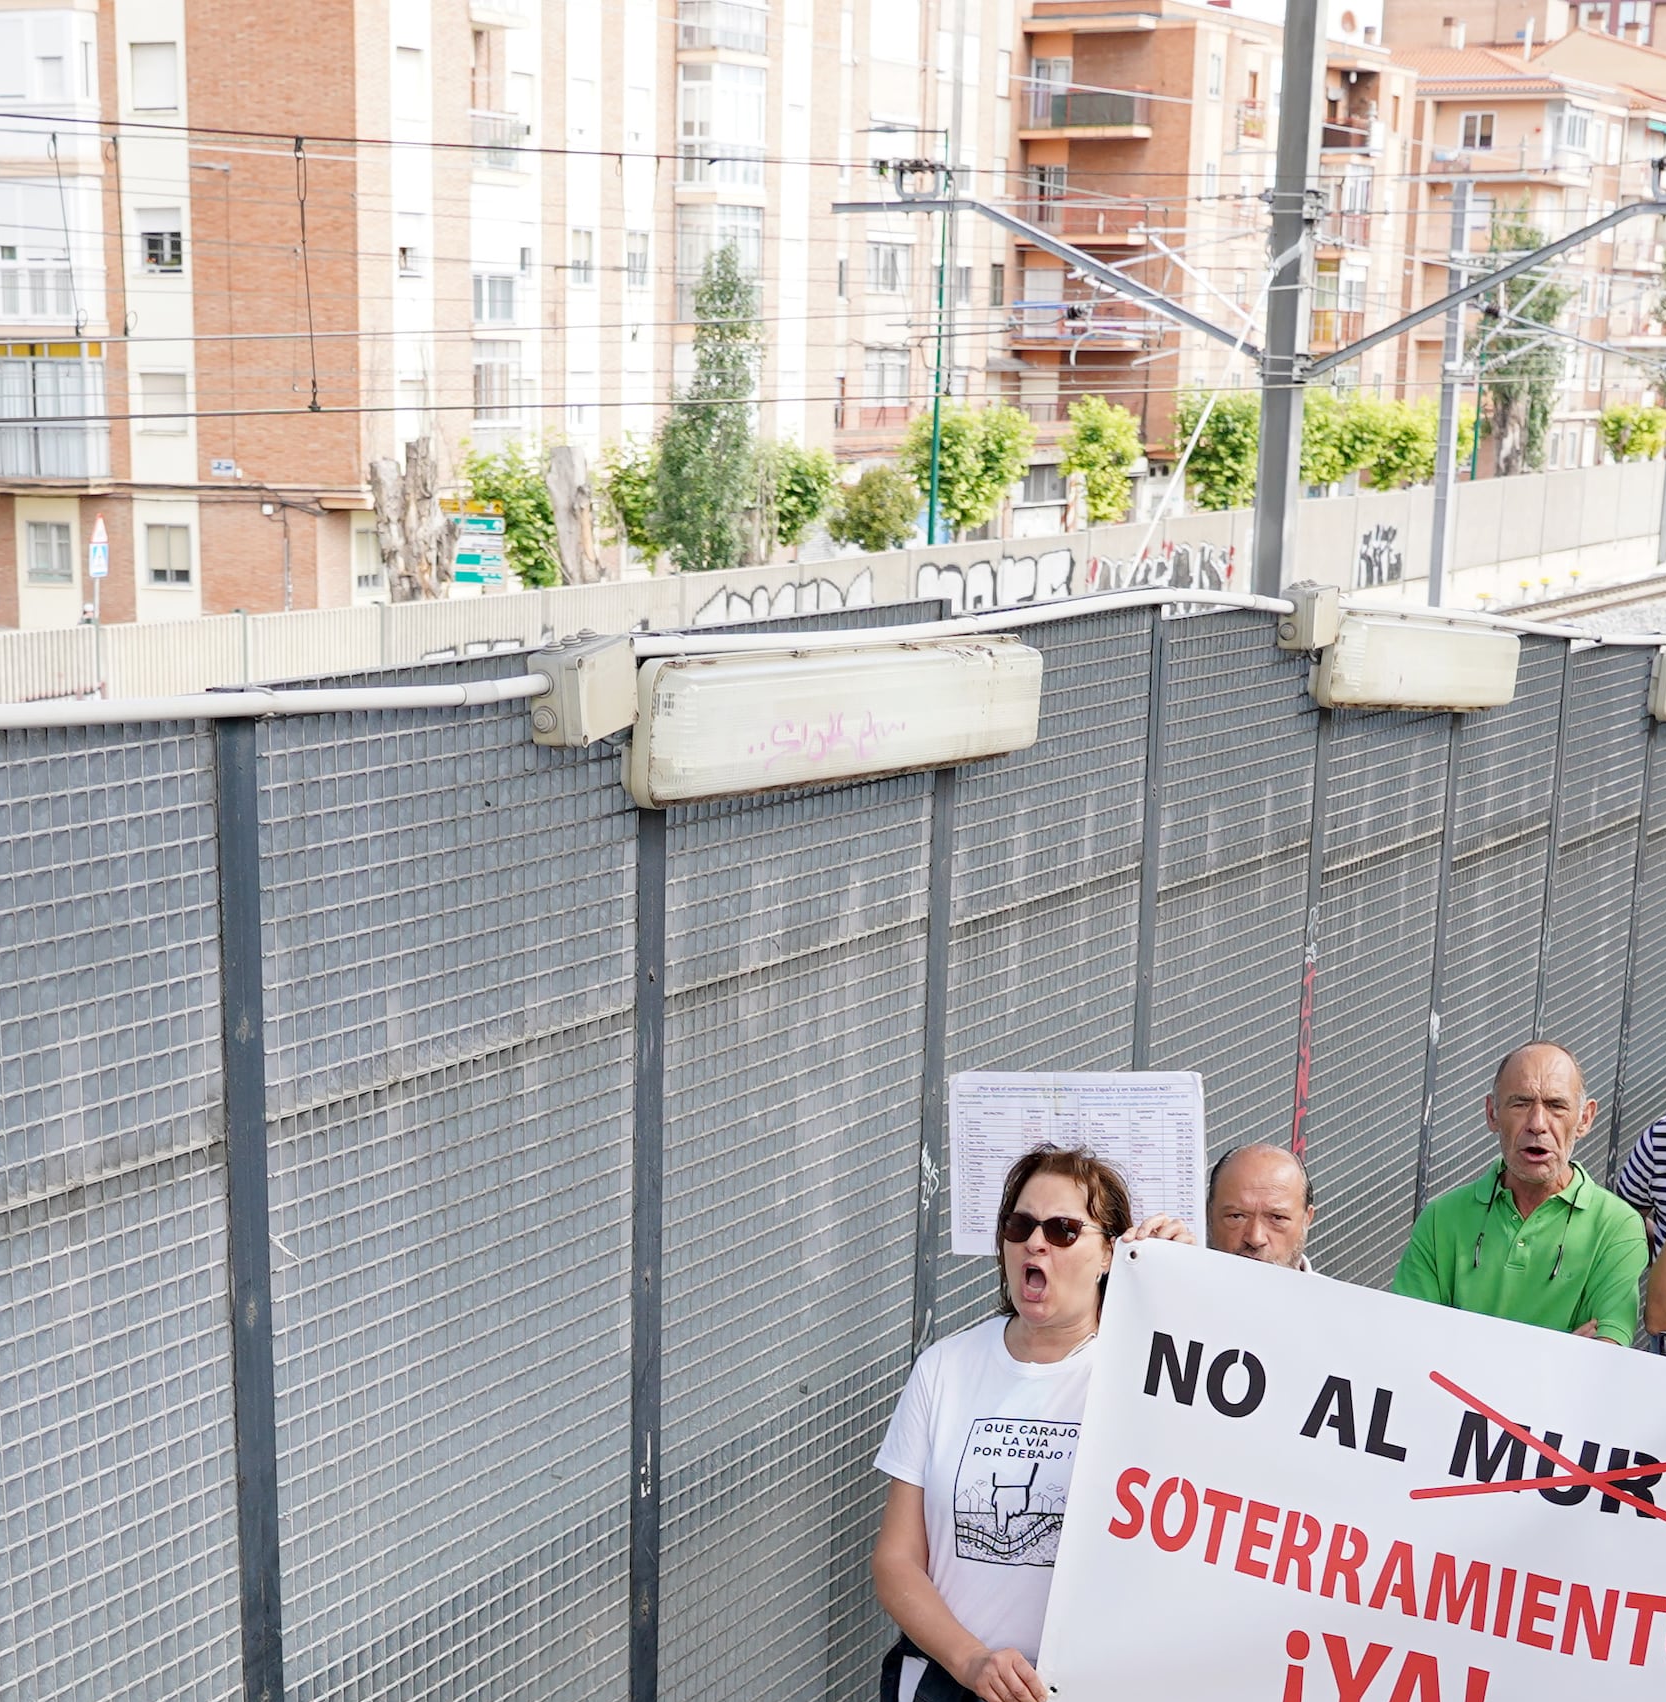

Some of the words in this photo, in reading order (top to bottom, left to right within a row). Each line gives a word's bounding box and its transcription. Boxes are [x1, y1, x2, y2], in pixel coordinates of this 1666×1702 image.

[1142, 1330, 1267, 1418] NO
[1299, 1374, 1407, 1462] AL
[984, 1423, 1014, 1433] QUE
[1002, 1437, 1019, 1446] LA
[1026, 1437, 1049, 1447] VÍA
[973, 1447, 1002, 1457] POR
[1007, 1450, 1063, 1460] DEBAJO
